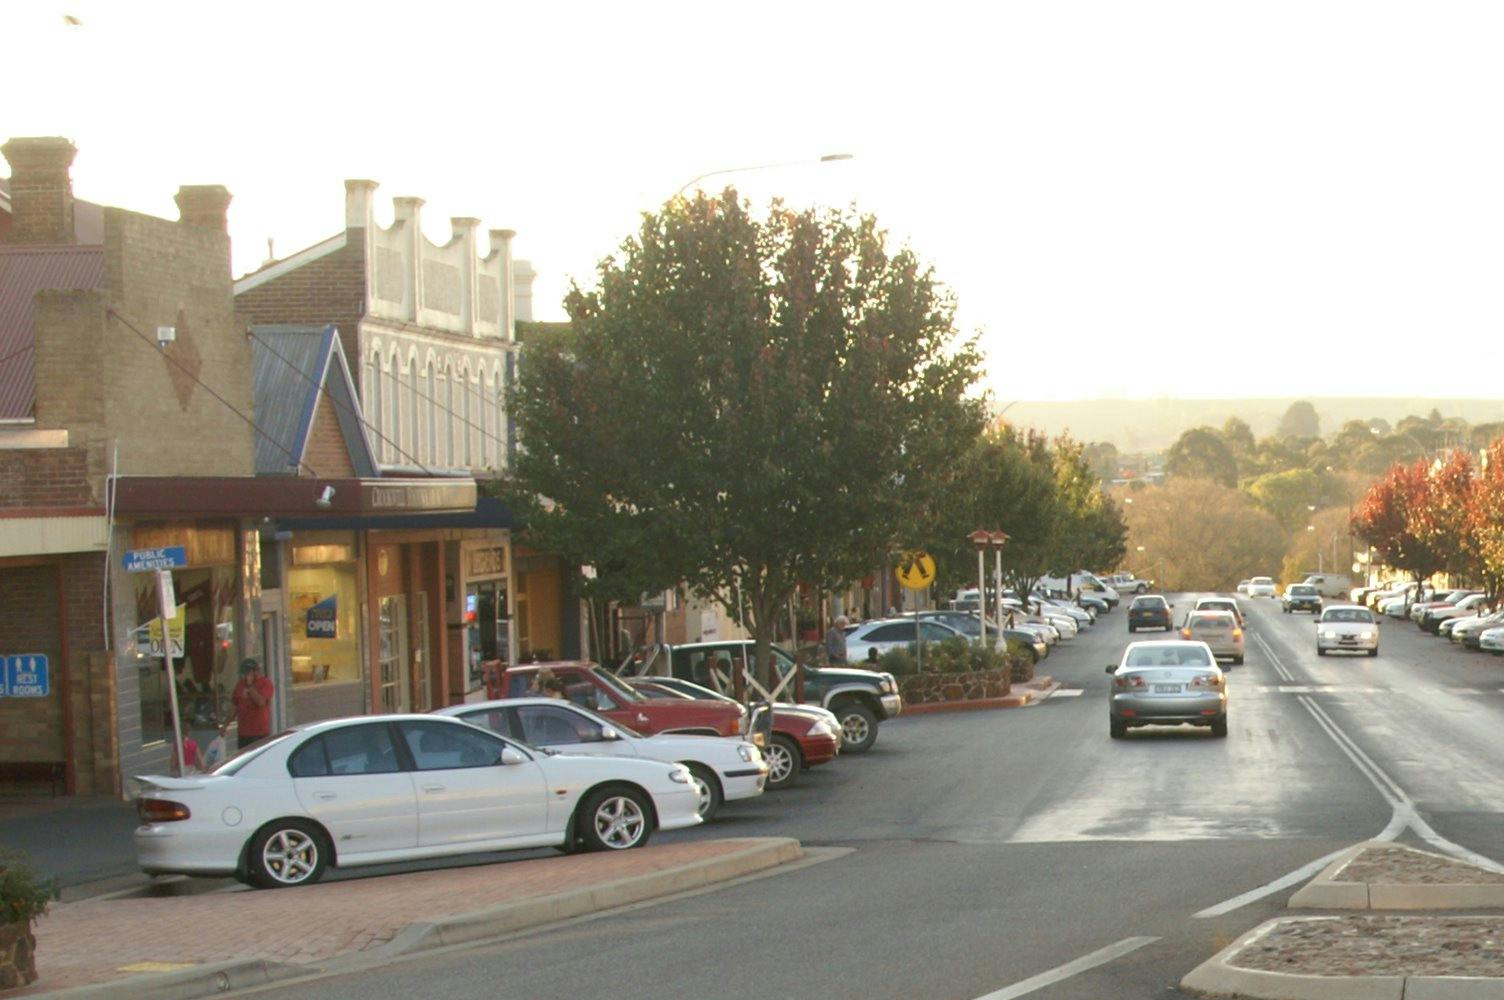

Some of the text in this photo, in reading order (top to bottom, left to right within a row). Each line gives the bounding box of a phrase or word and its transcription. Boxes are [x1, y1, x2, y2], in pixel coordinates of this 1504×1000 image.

[133, 549, 165, 561] PUBLIC
[127, 558, 175, 571] AMENITIES
[308, 620, 335, 631] OPEN
[16, 674, 37, 684] REST
[13, 685, 43, 696] ROOMS
